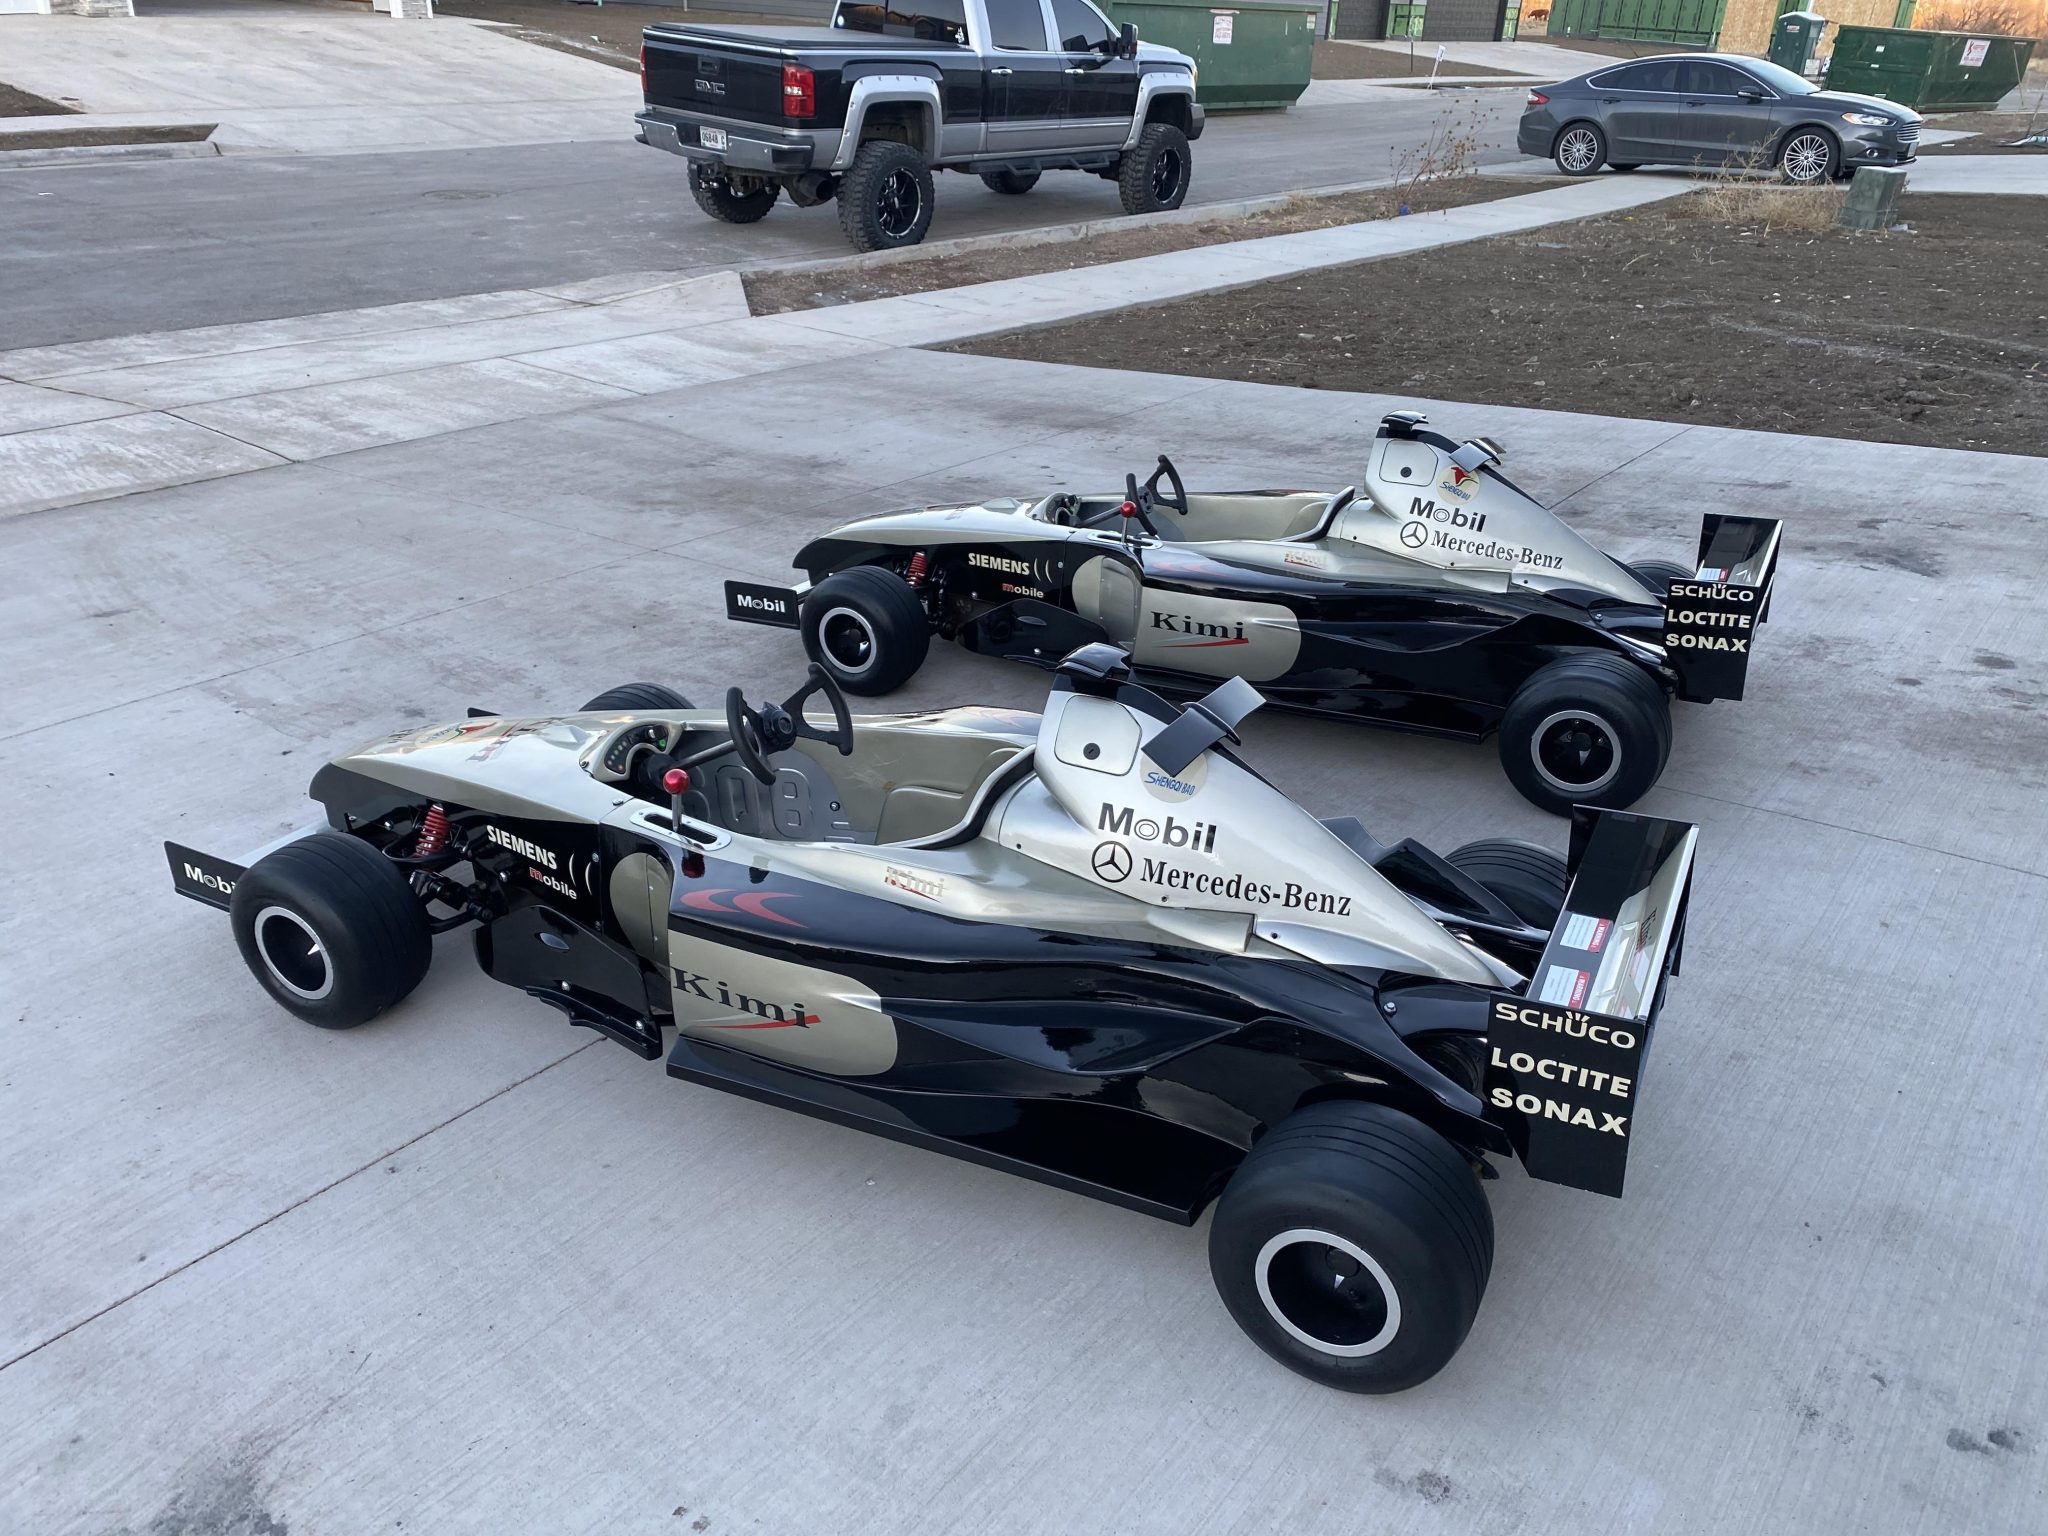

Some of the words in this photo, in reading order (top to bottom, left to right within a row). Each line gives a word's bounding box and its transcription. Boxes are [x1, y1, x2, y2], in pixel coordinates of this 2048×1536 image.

[695, 79, 725, 95] GMC
[1409, 497, 1486, 533] Mobil
[968, 552, 1030, 576] SIEMENS
[1430, 530, 1563, 570] Mercedes-Benz
[736, 594, 786, 613] Mobil
[1002, 583, 1044, 599] mobile
[1670, 583, 1754, 602] SCHÜCO
[1150, 610, 1244, 640] Kimi
[1667, 609, 1752, 629] LOCTITE
[1665, 633, 1748, 653] SONAX
[1144, 771, 1183, 792] SHENGQI
[1098, 802, 1217, 854] Mobil
[486, 824, 558, 870] SIEMENS
[529, 866, 577, 900] mobile
[1140, 857, 1352, 917] Mercedes-Benz
[671, 966, 810, 1029] Kimi
[1495, 1002, 1636, 1049] SCHÜCO
[1490, 1047, 1632, 1098] LOCTITE
[1490, 1087, 1628, 1137] SONAX
